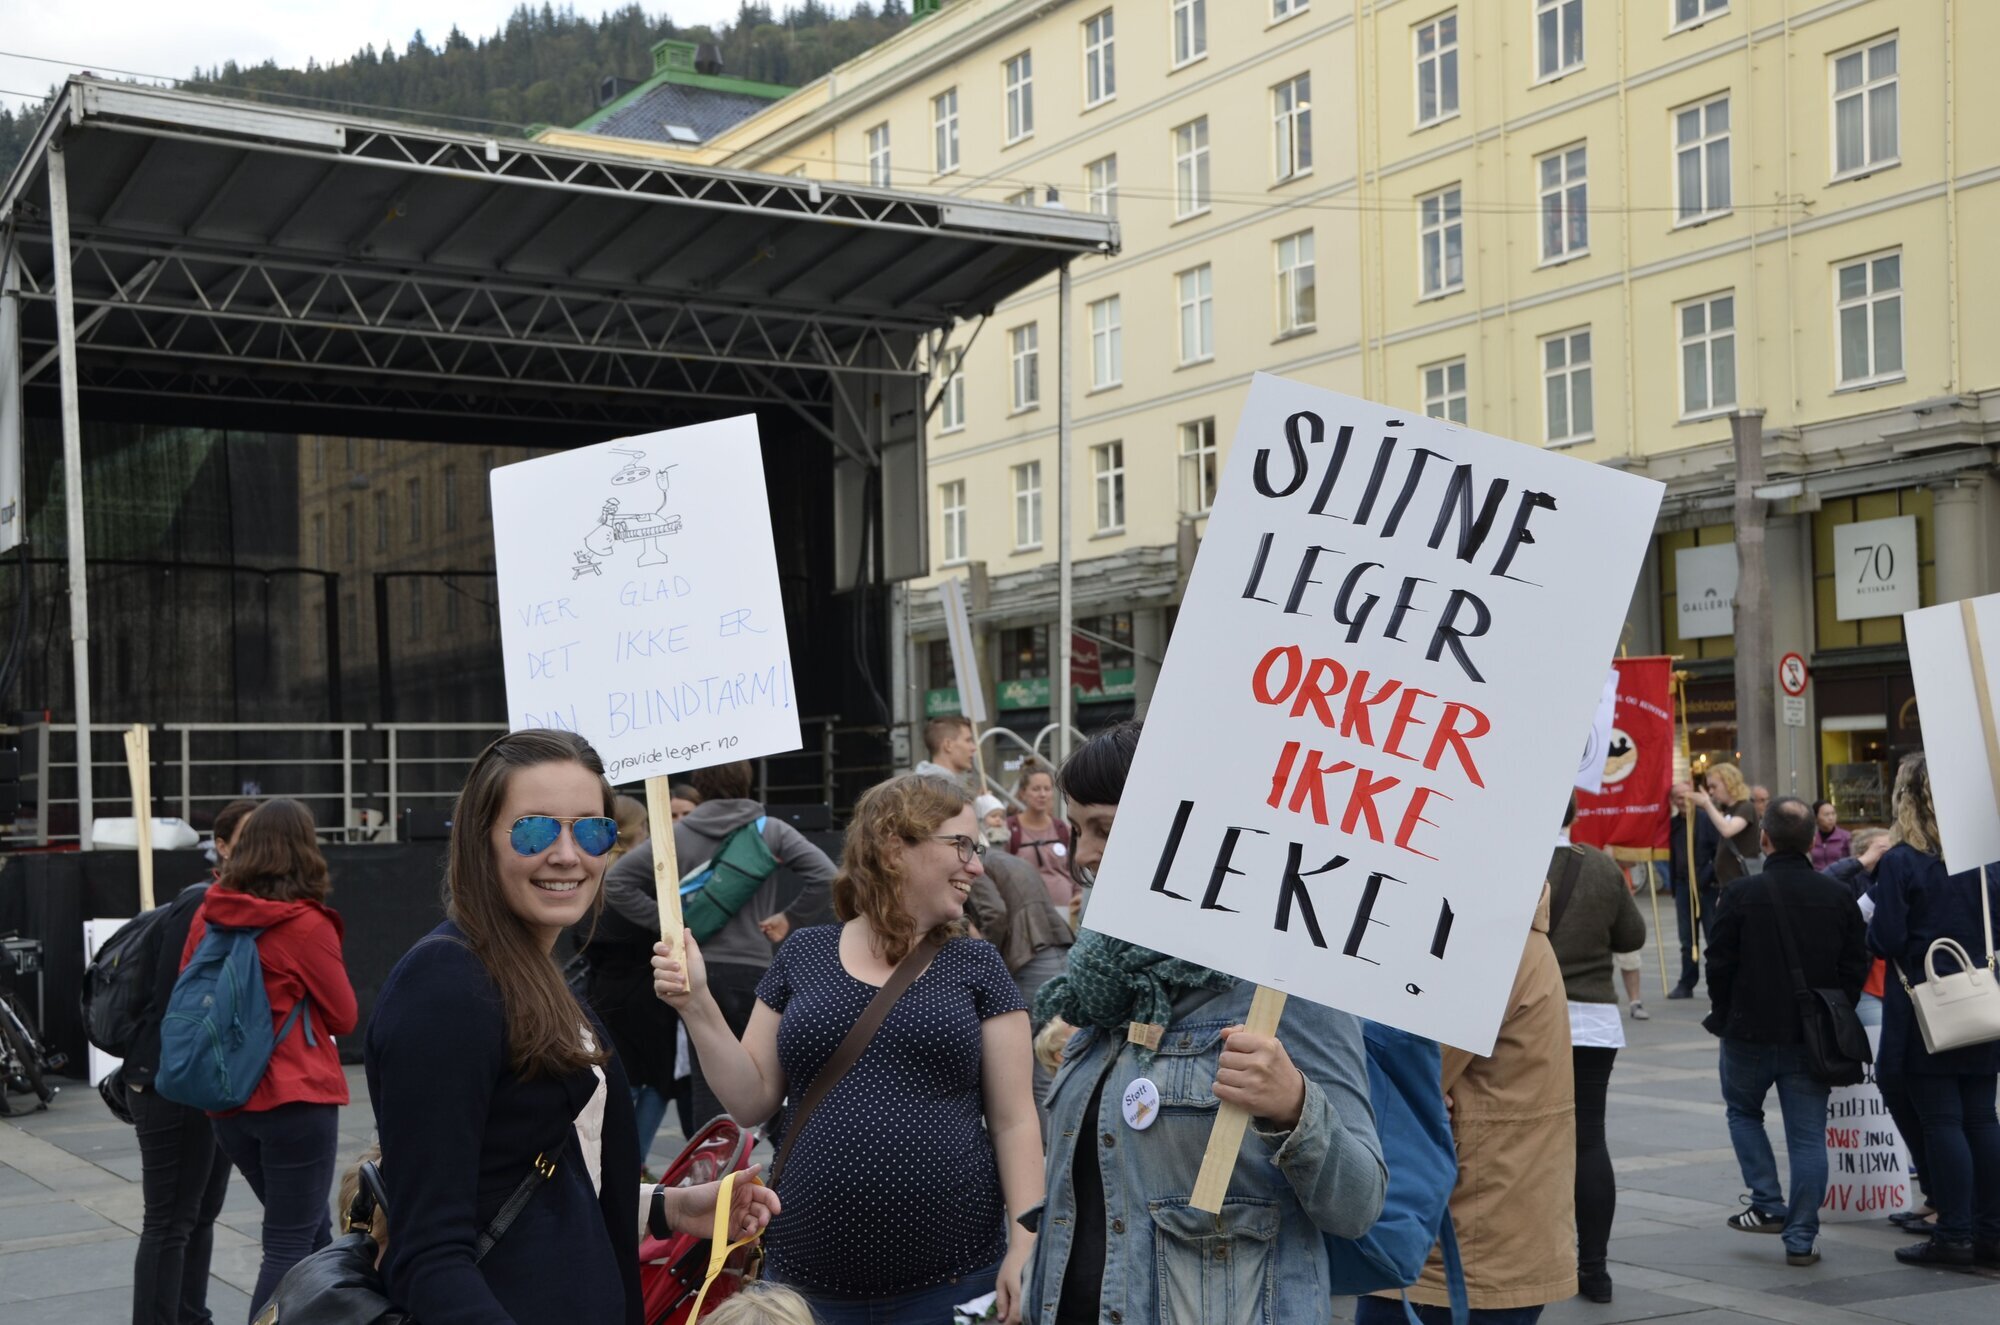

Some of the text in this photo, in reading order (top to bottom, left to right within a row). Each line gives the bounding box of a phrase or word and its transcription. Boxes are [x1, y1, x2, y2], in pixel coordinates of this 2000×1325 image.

[518, 575, 691, 627] VÆR GLAD
[1854, 543, 1894, 583] 70
[528, 608, 769, 680] DET IKKE ER
[1241, 532, 1492, 683] LEGER
[608, 660, 791, 738] BLINDTARM!
[1251, 644, 1491, 789] ORKER
[1266, 741, 1454, 861] IKKE
